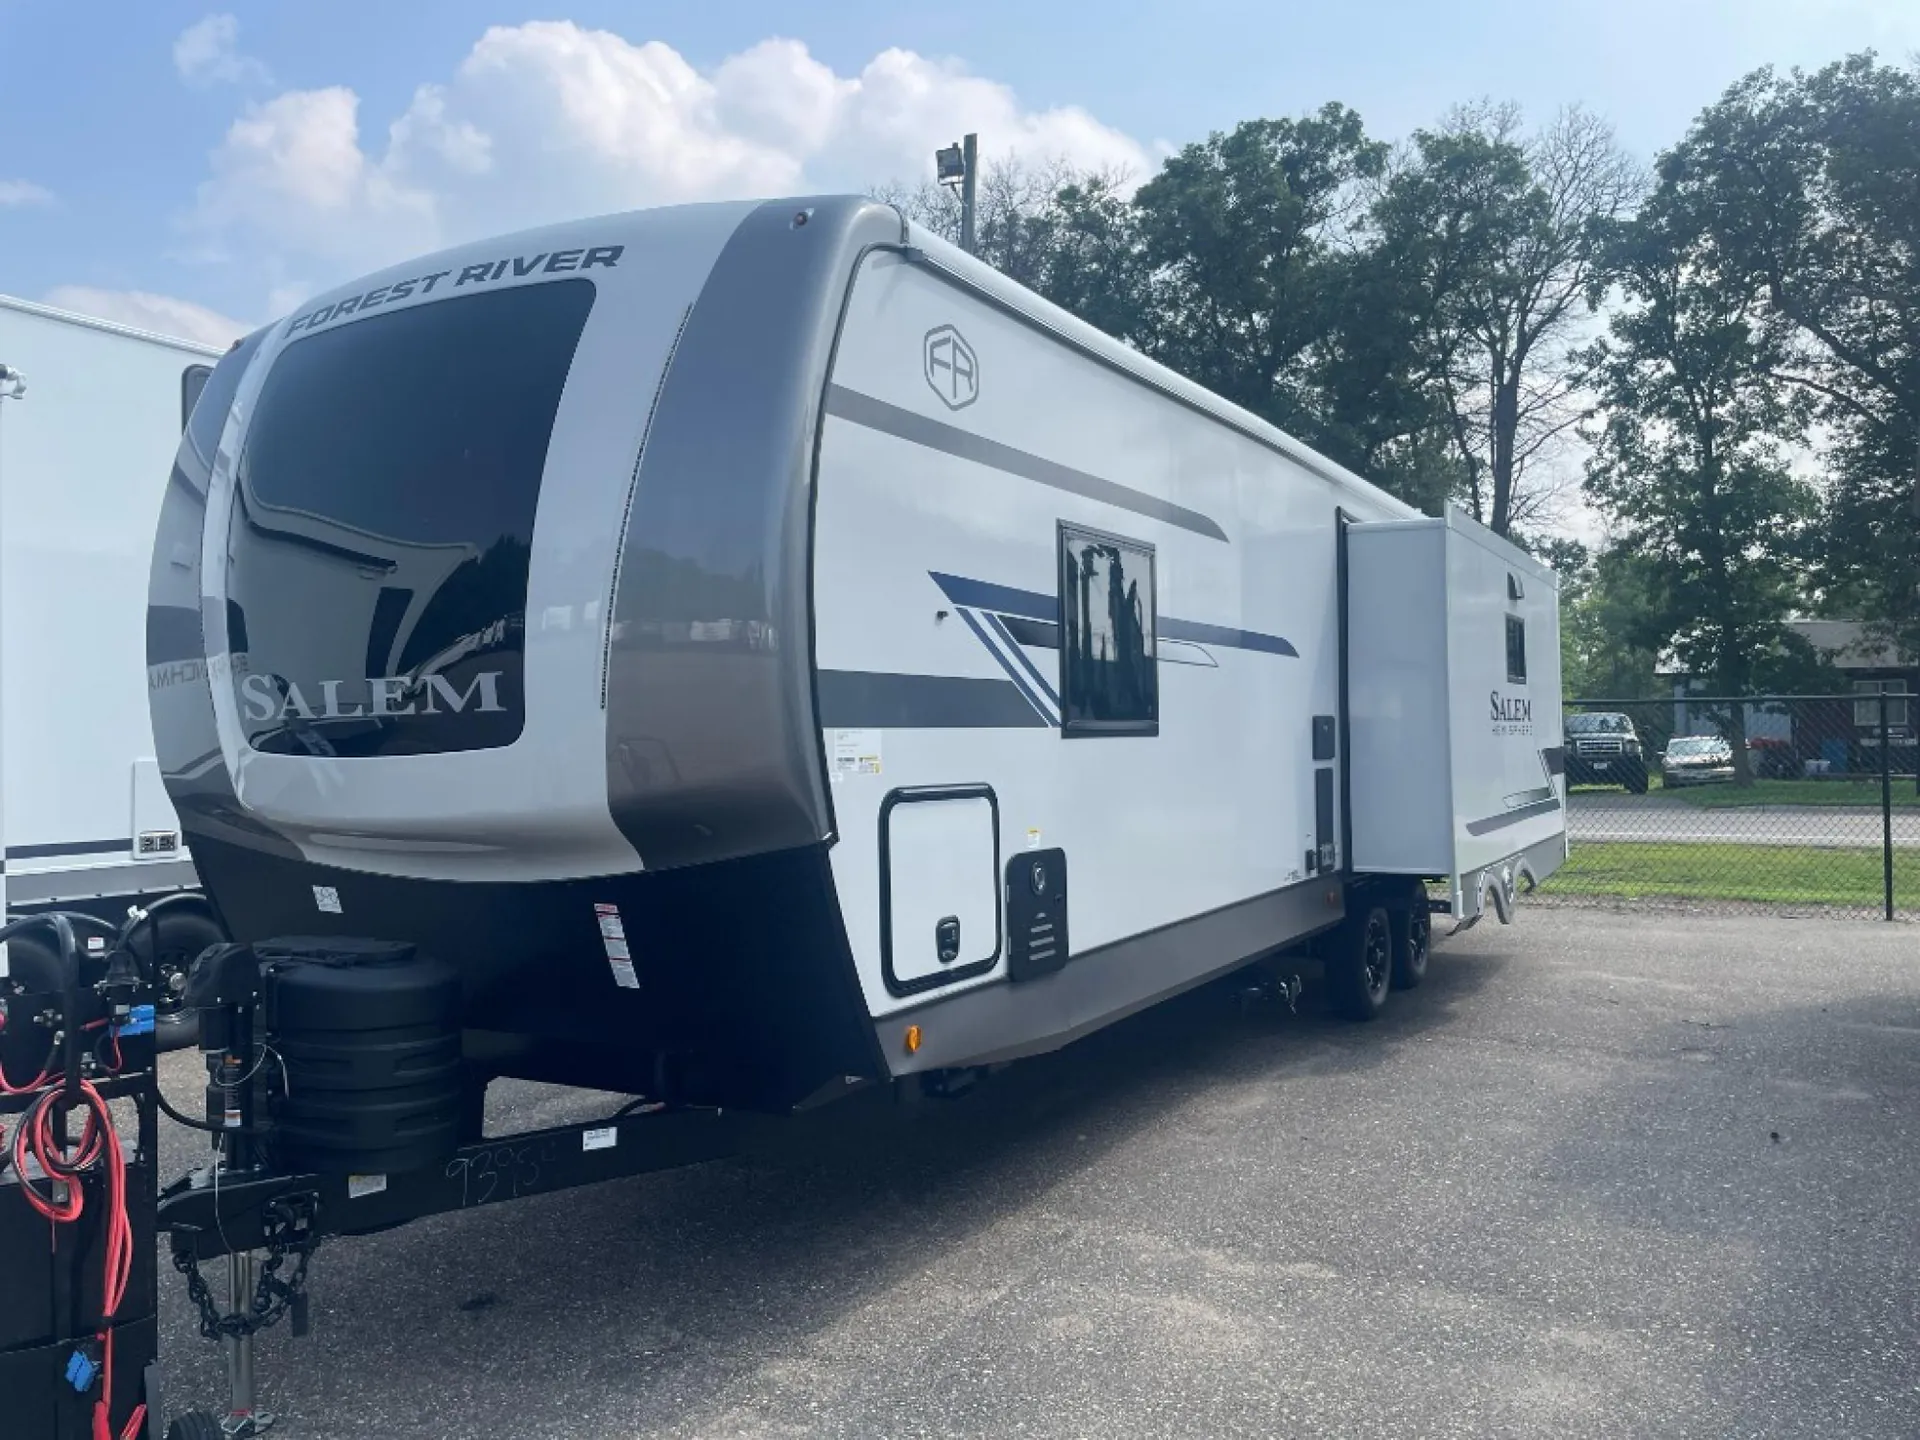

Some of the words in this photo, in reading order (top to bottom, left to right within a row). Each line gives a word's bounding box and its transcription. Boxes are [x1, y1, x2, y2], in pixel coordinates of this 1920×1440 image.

[283, 269, 452, 340] FOREST
[455, 245, 625, 288] RIVER
[241, 670, 508, 722] SALEM
[1490, 689, 1533, 722] SALEM
